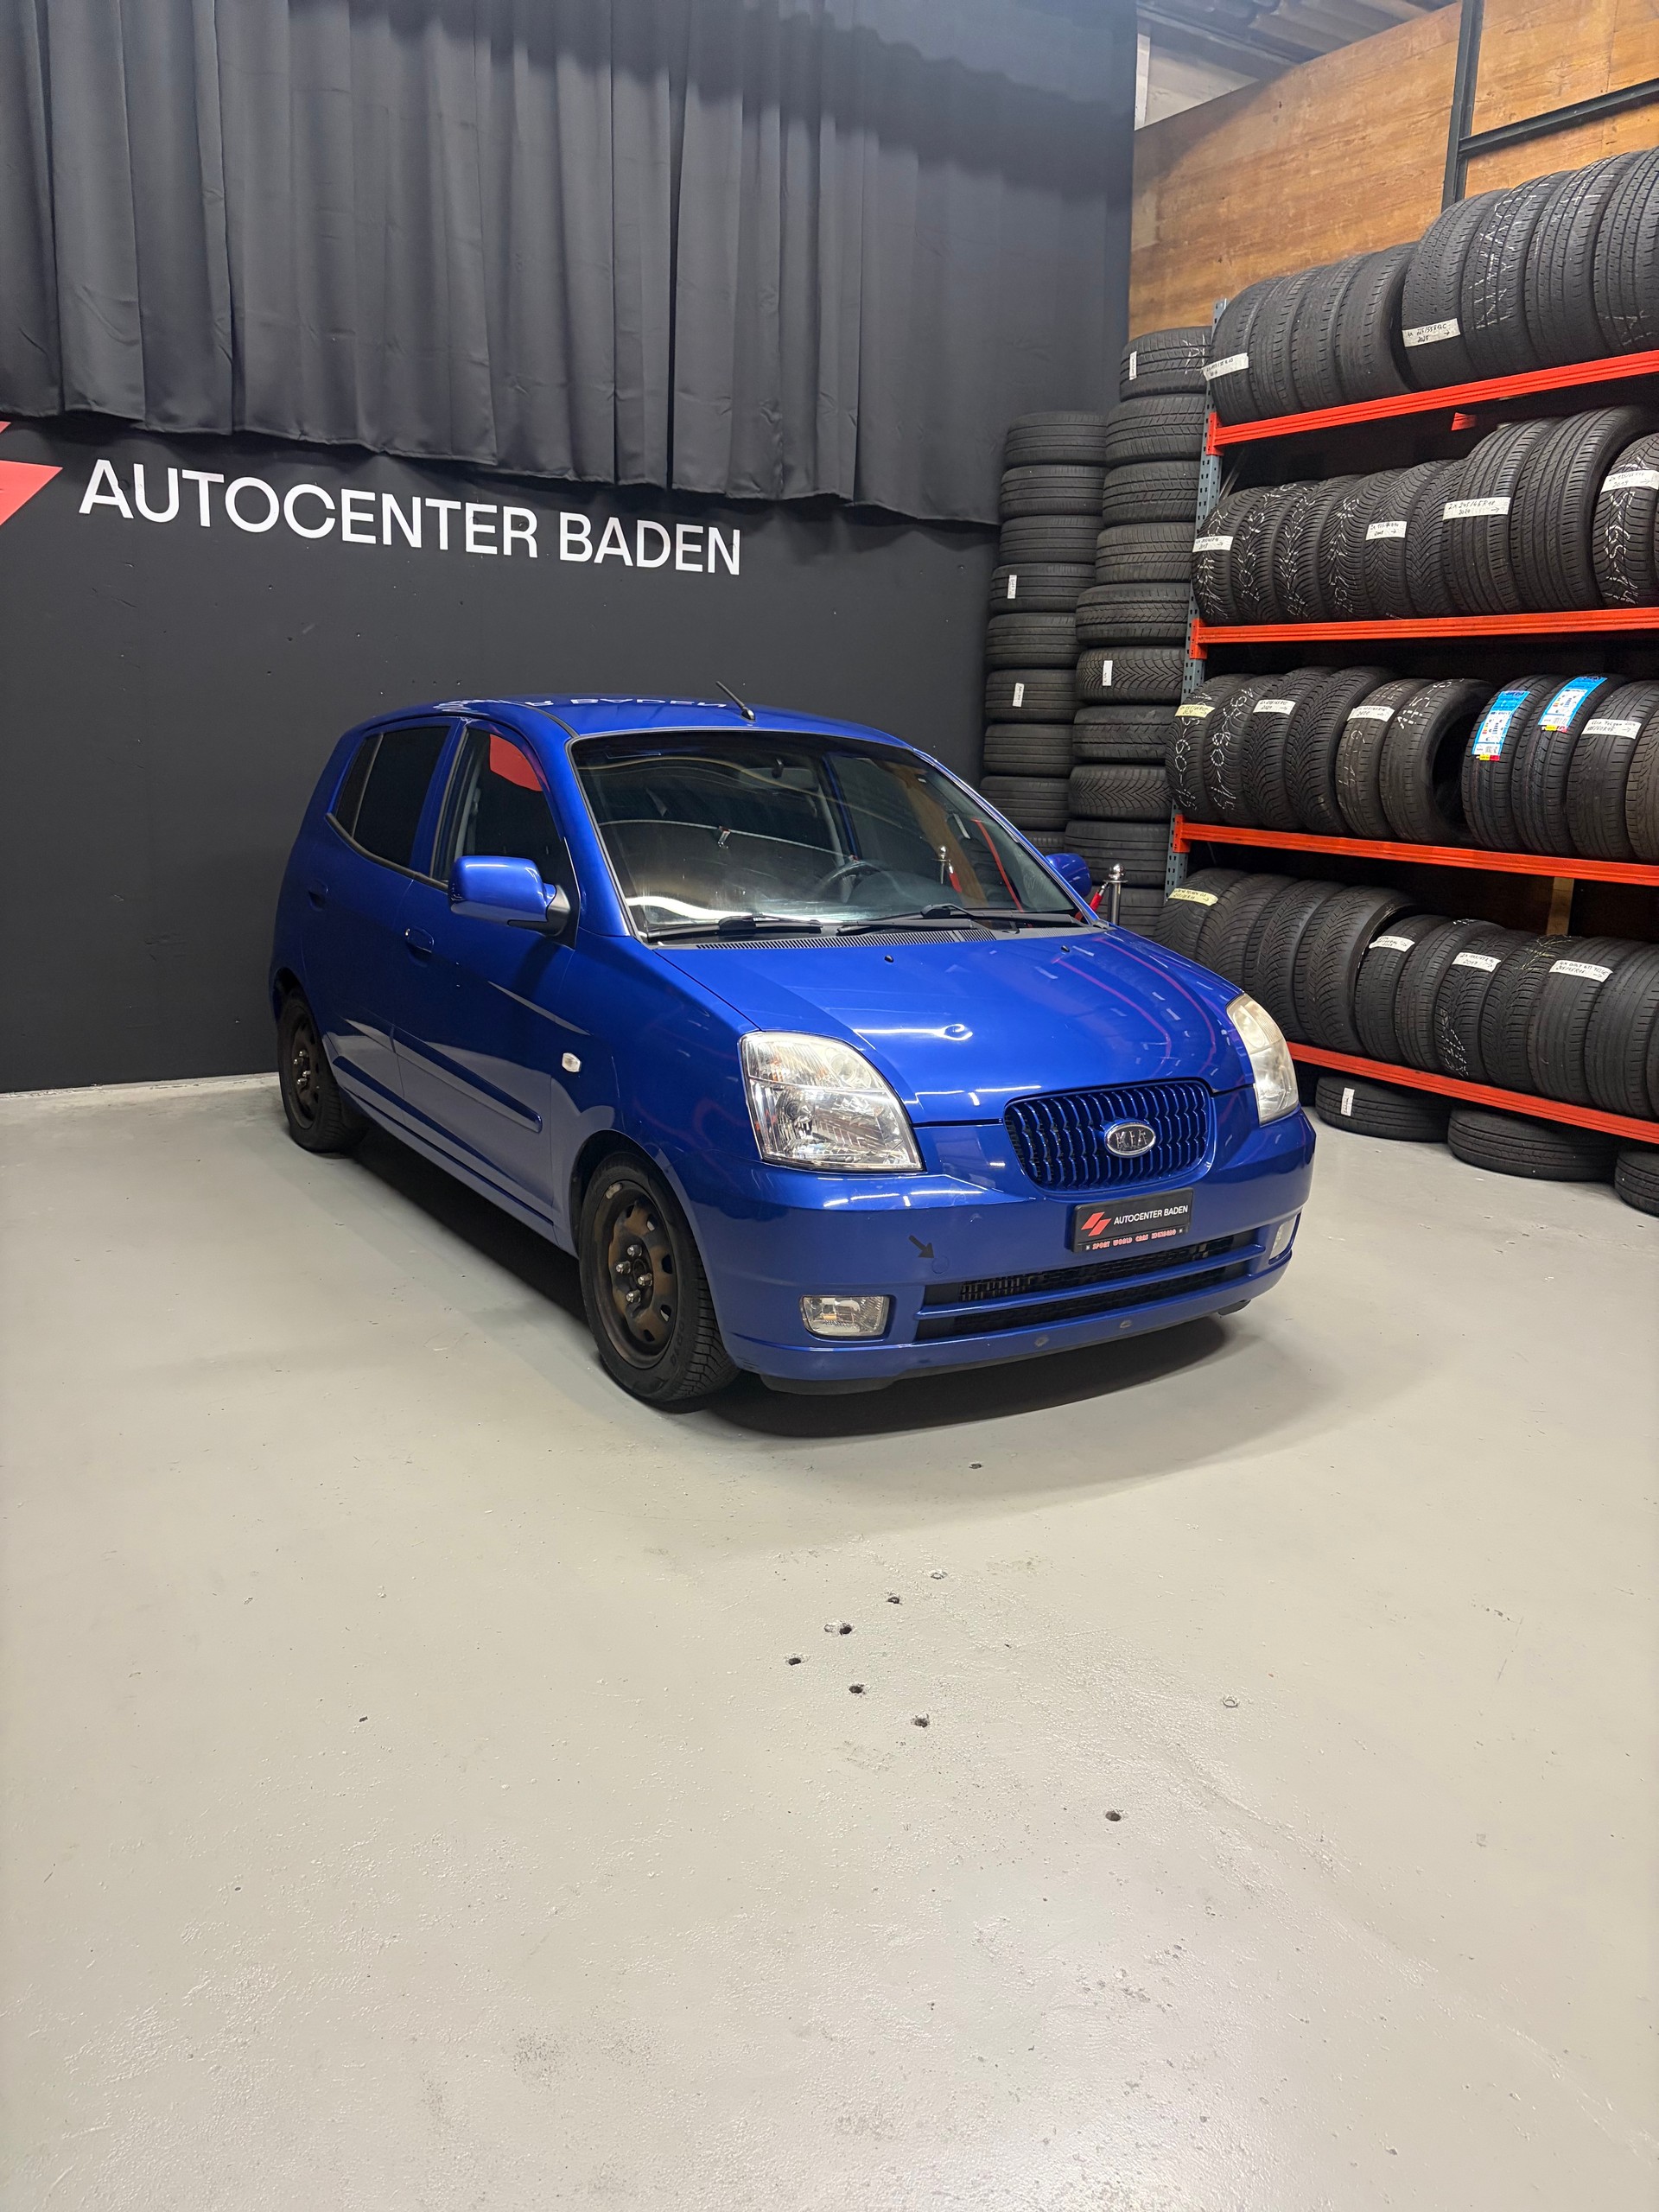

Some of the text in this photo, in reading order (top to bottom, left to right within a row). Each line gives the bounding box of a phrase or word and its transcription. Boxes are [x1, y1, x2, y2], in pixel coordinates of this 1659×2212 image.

[79, 459, 741, 575] AUTOCENTER BADEN
[1115, 1129, 1147, 1150] KIA
[1113, 1205, 1189, 1225] AUTOCENTER BADEN
[1091, 1241, 1111, 1250] SPORT
[1112, 1236, 1133, 1247] WORLD
[1135, 1233, 1149, 1243] CARS
